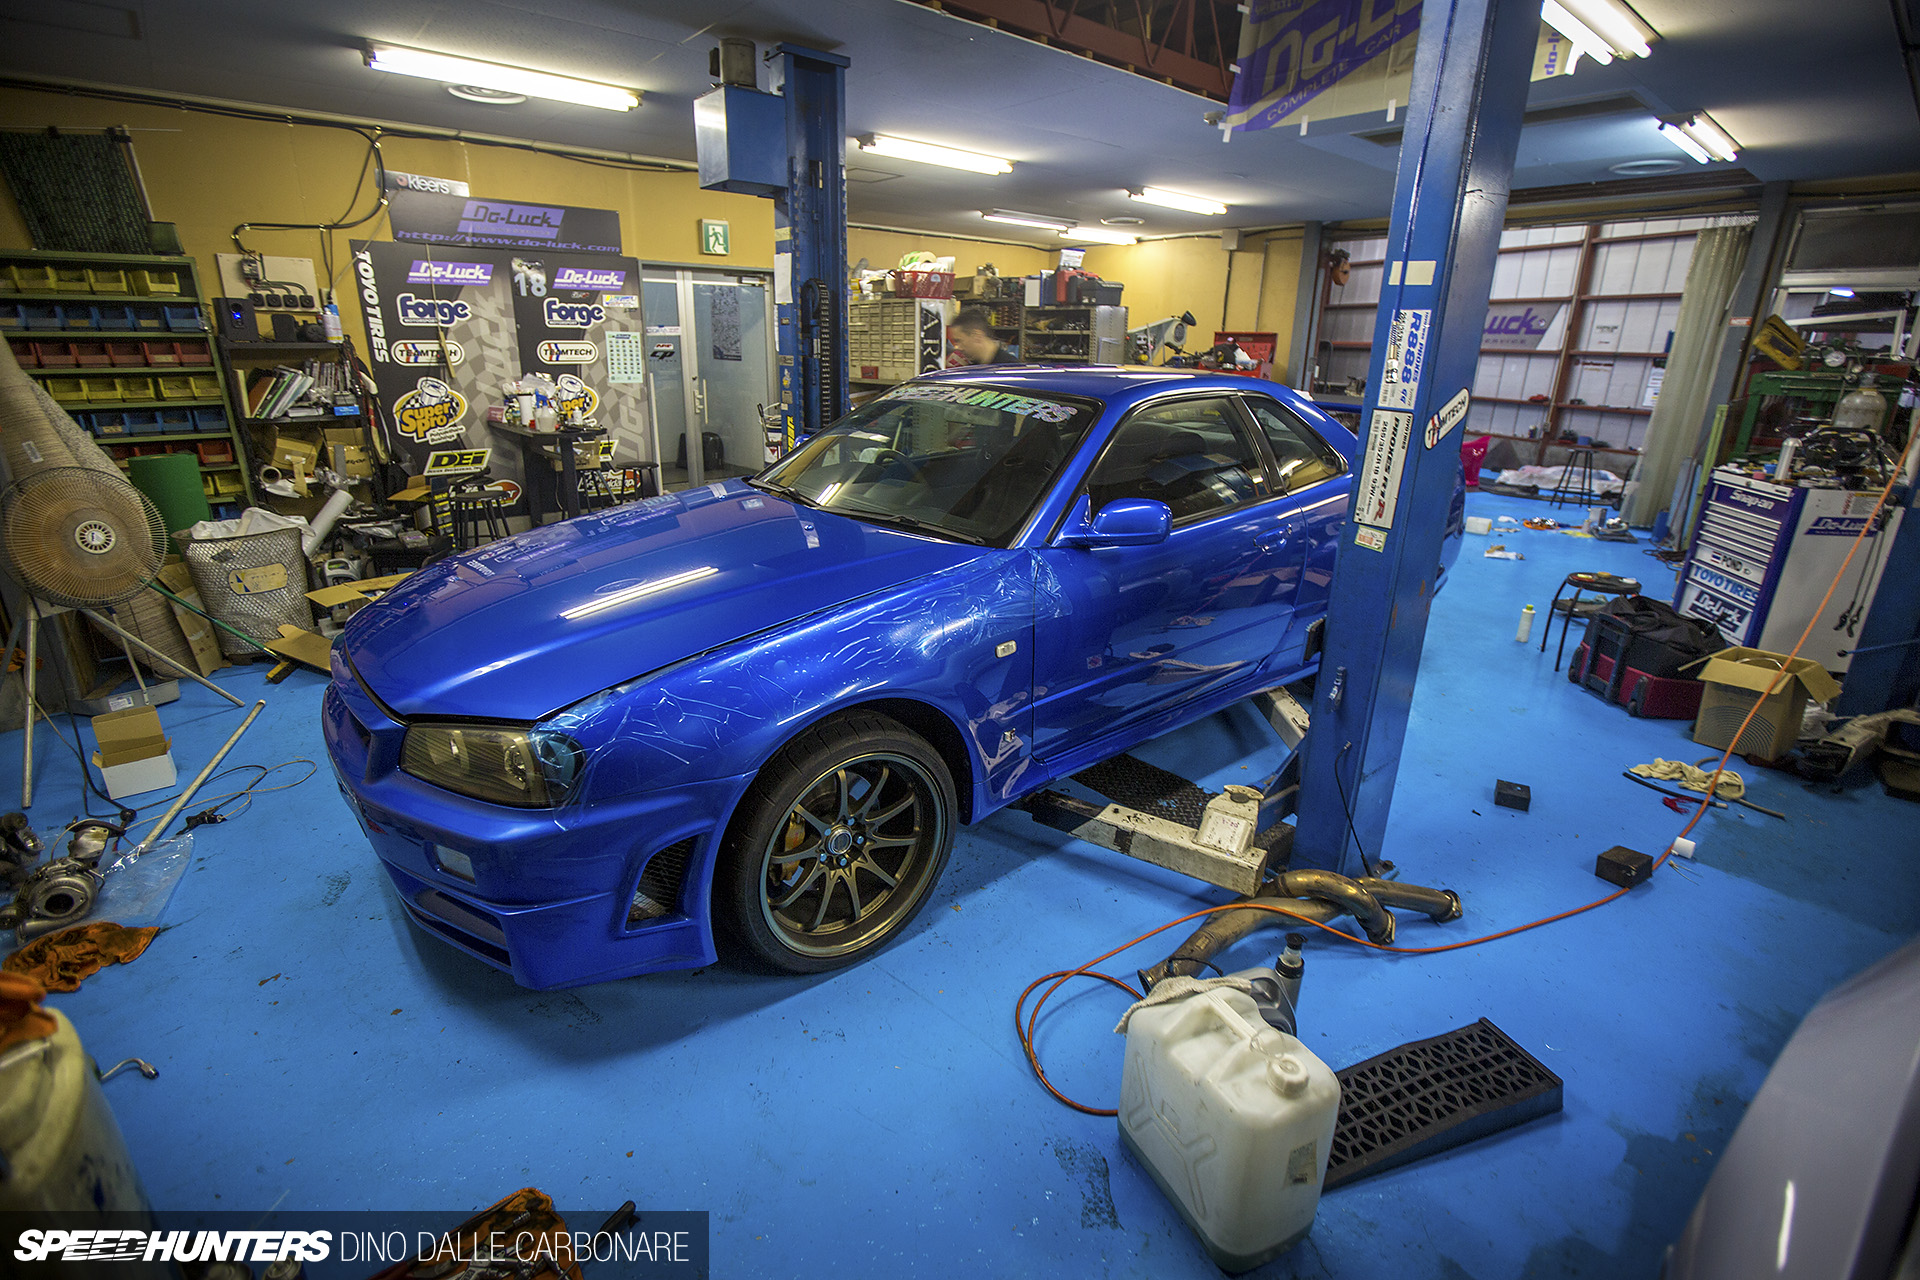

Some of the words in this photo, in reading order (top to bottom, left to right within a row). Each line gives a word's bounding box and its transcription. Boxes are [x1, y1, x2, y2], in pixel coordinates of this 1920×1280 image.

[1267, 58, 1350, 121] COMPLETE
[1364, 24, 1402, 54] CAR
[410, 262, 491, 280] Do-Luck
[514, 272, 547, 297] 18
[556, 270, 624, 285] Do-Luck
[543, 348, 593, 356] TEAMTECH
[1402, 312, 1422, 384] R888
[1413, 342, 1424, 383] PROXES
[1385, 416, 1400, 474] PROXES
